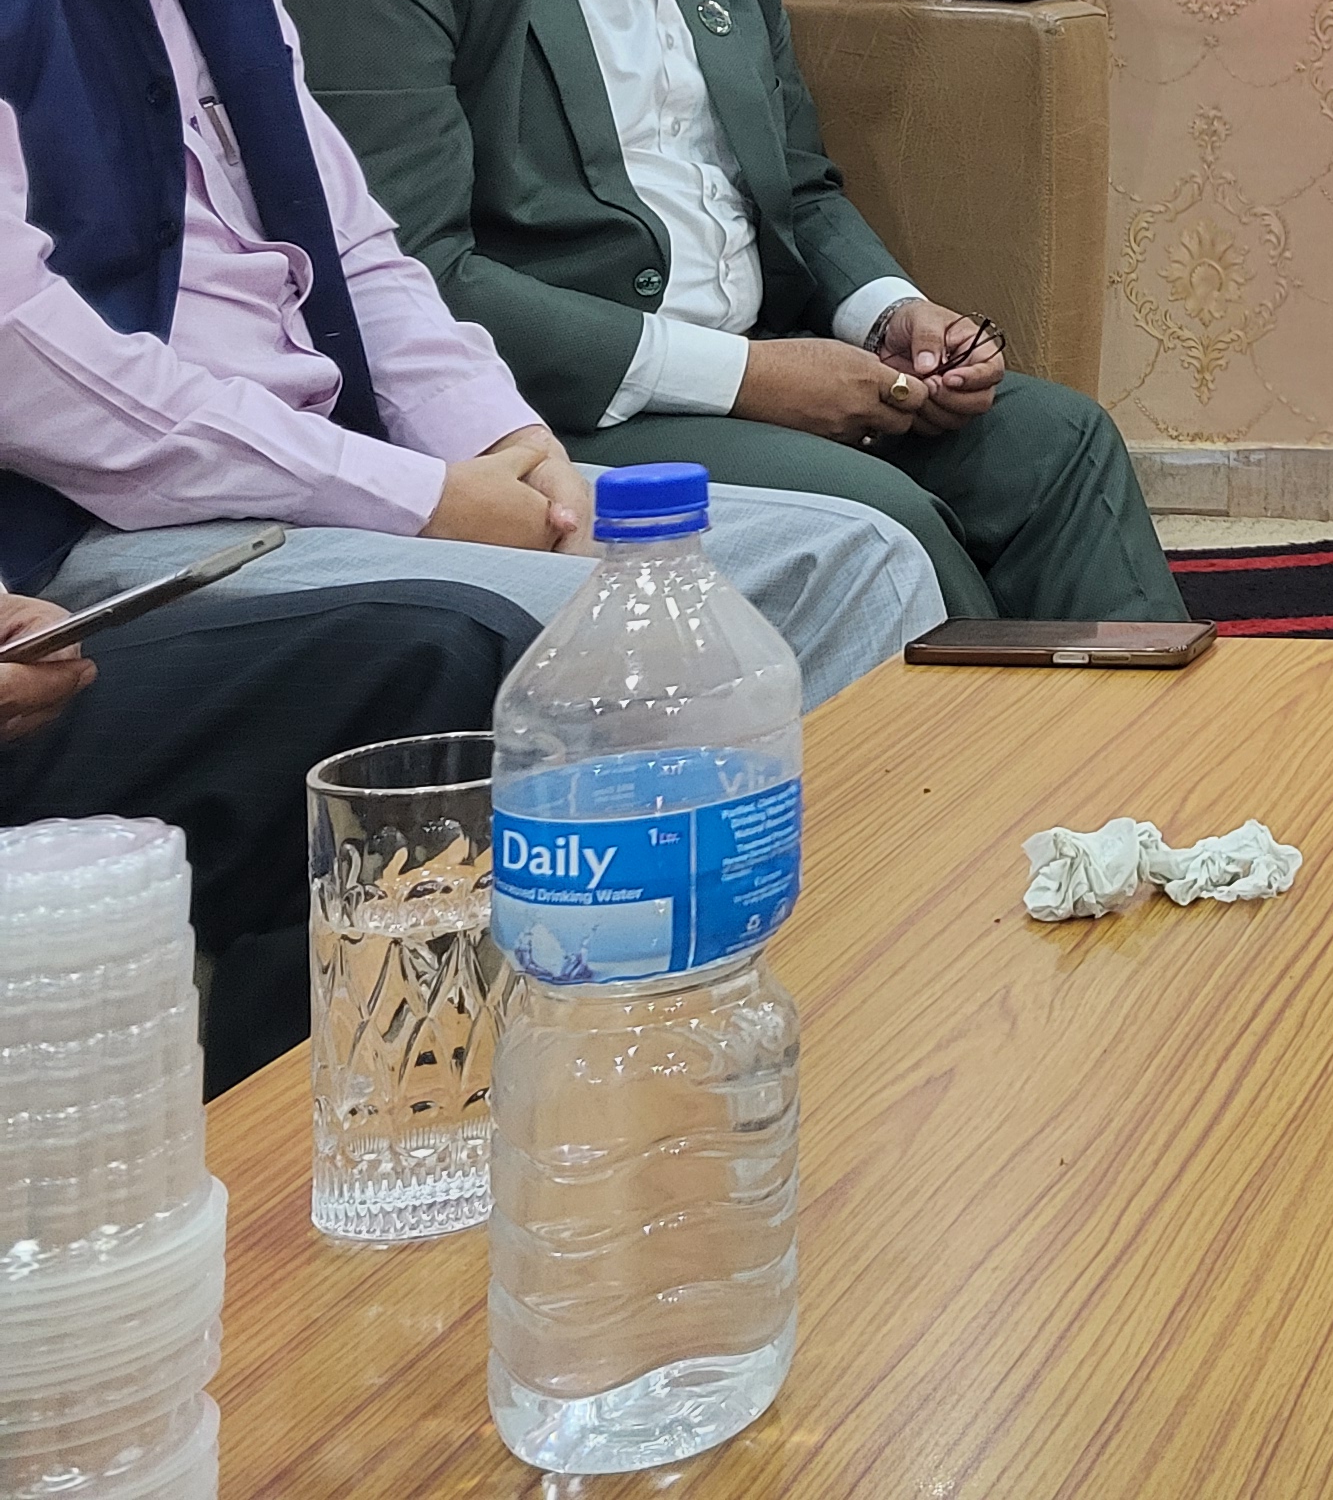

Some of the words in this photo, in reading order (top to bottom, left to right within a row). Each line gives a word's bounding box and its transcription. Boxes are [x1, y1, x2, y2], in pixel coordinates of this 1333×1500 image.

[648, 828, 659, 846] 1
[502, 829, 619, 889] Daily
[537, 888, 593, 905] Drinking
[595, 888, 644, 902] Water
